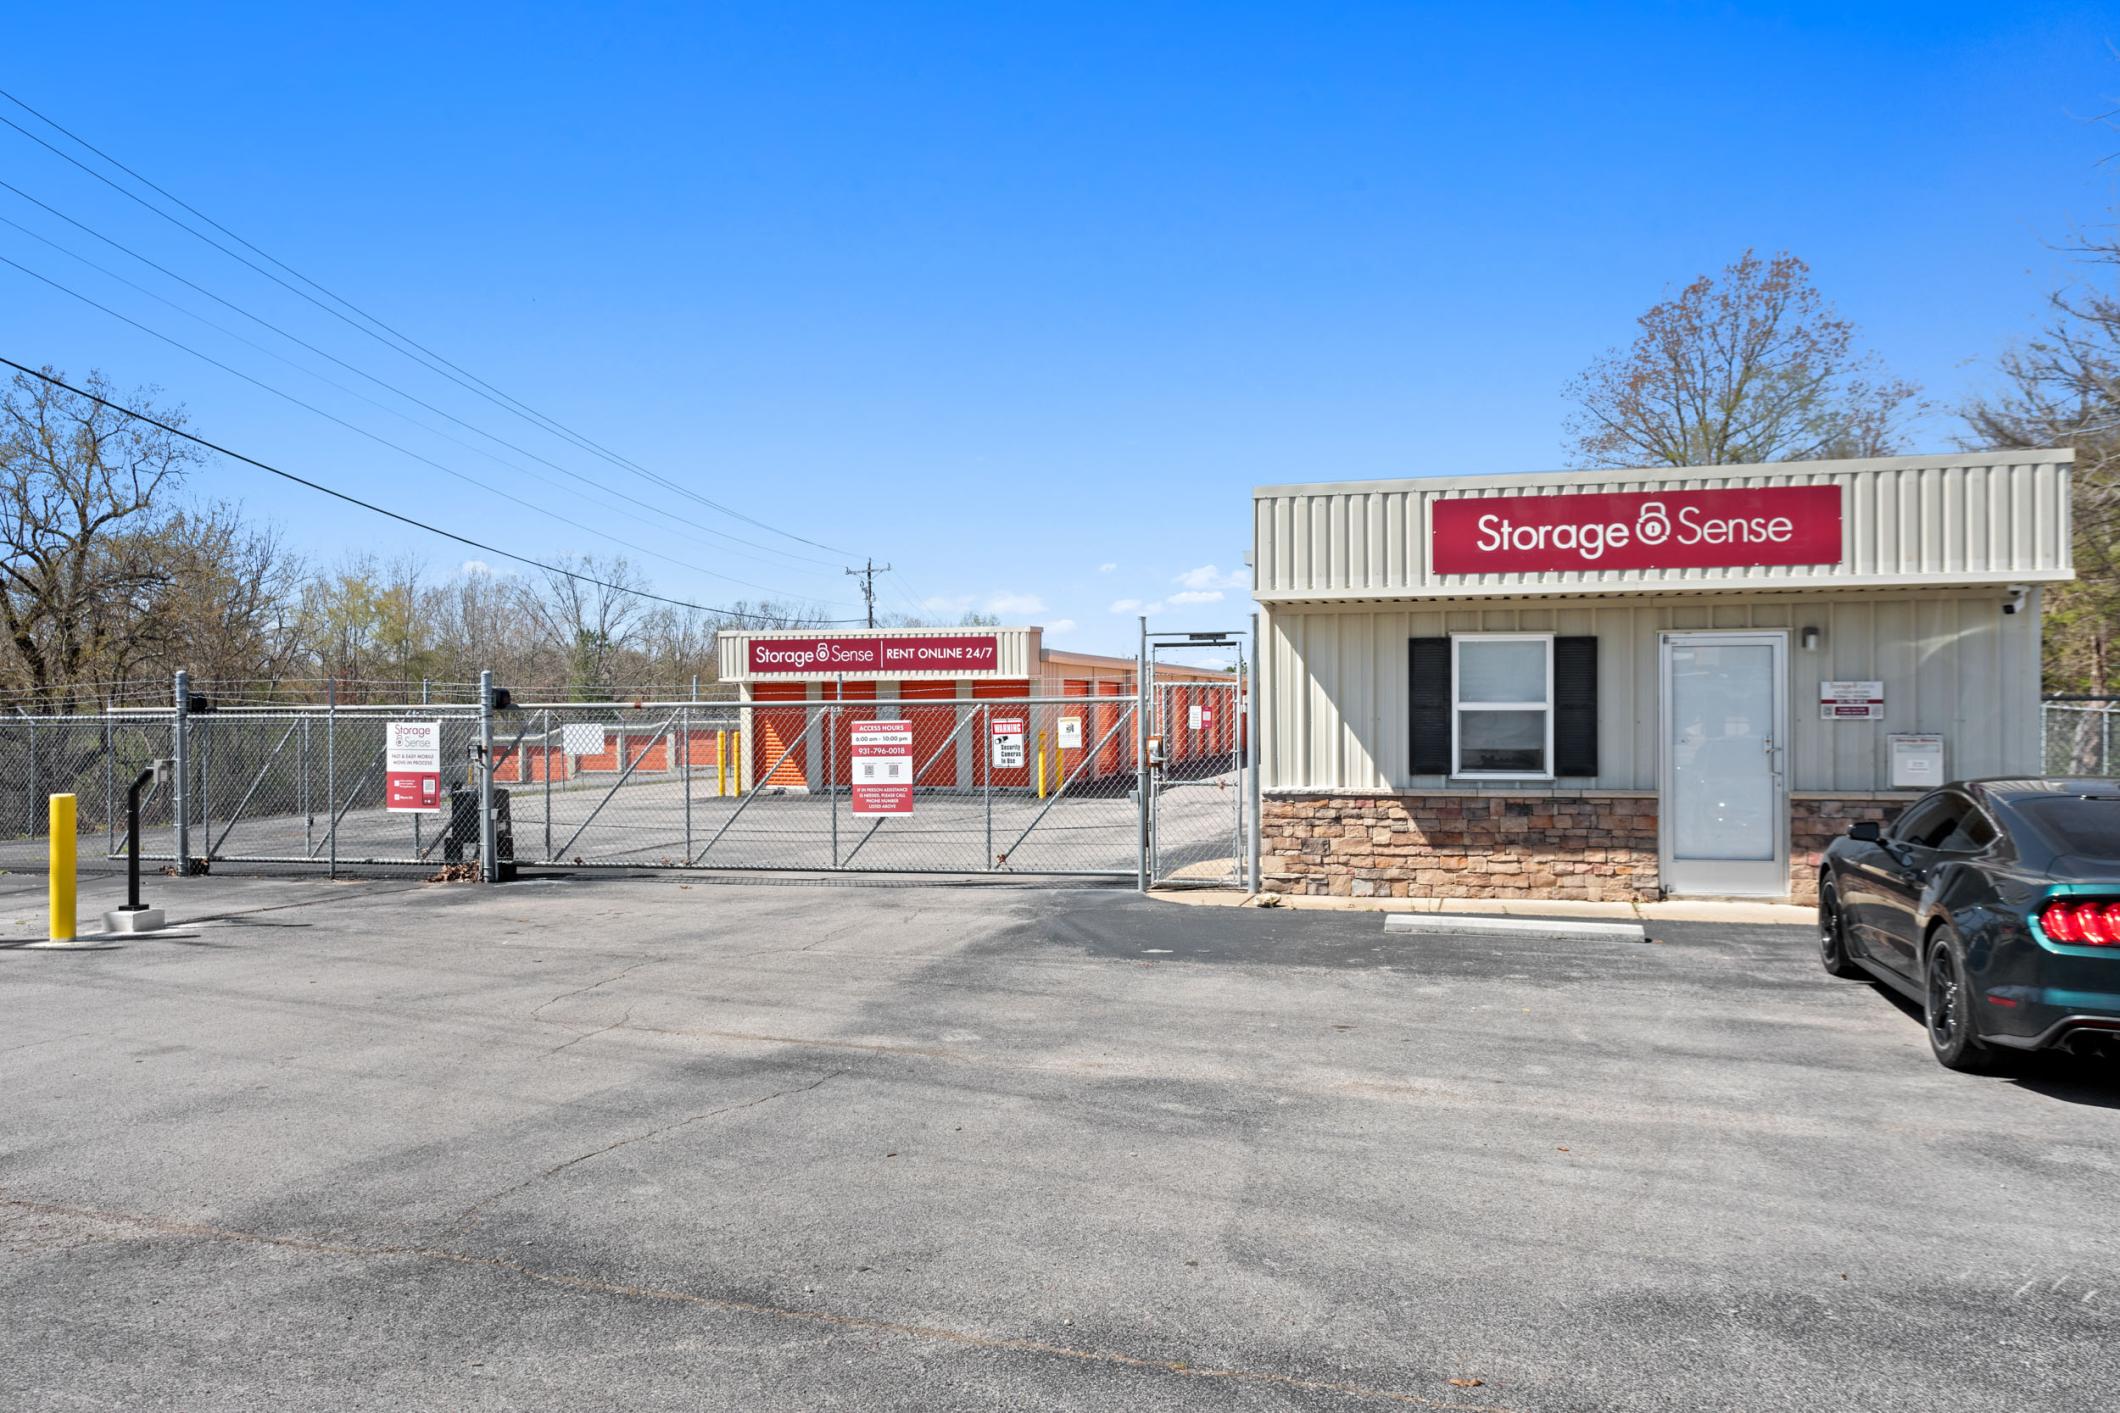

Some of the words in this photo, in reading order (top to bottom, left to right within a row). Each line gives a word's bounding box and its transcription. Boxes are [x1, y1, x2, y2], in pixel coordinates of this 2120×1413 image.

[1476, 513, 1630, 560] Storage
[1676, 506, 1793, 545] Sense
[756, 646, 814, 667] Storage
[831, 645, 874, 662] Sense
[886, 647, 915, 660] RENT
[918, 646, 963, 659] ONLINE
[966, 646, 993, 660] 24/7
[394, 724, 431, 738] Storage
[994, 723, 1021, 733] WARNING
[404, 735, 431, 748] Sense
[1000, 744, 1021, 752] Security
